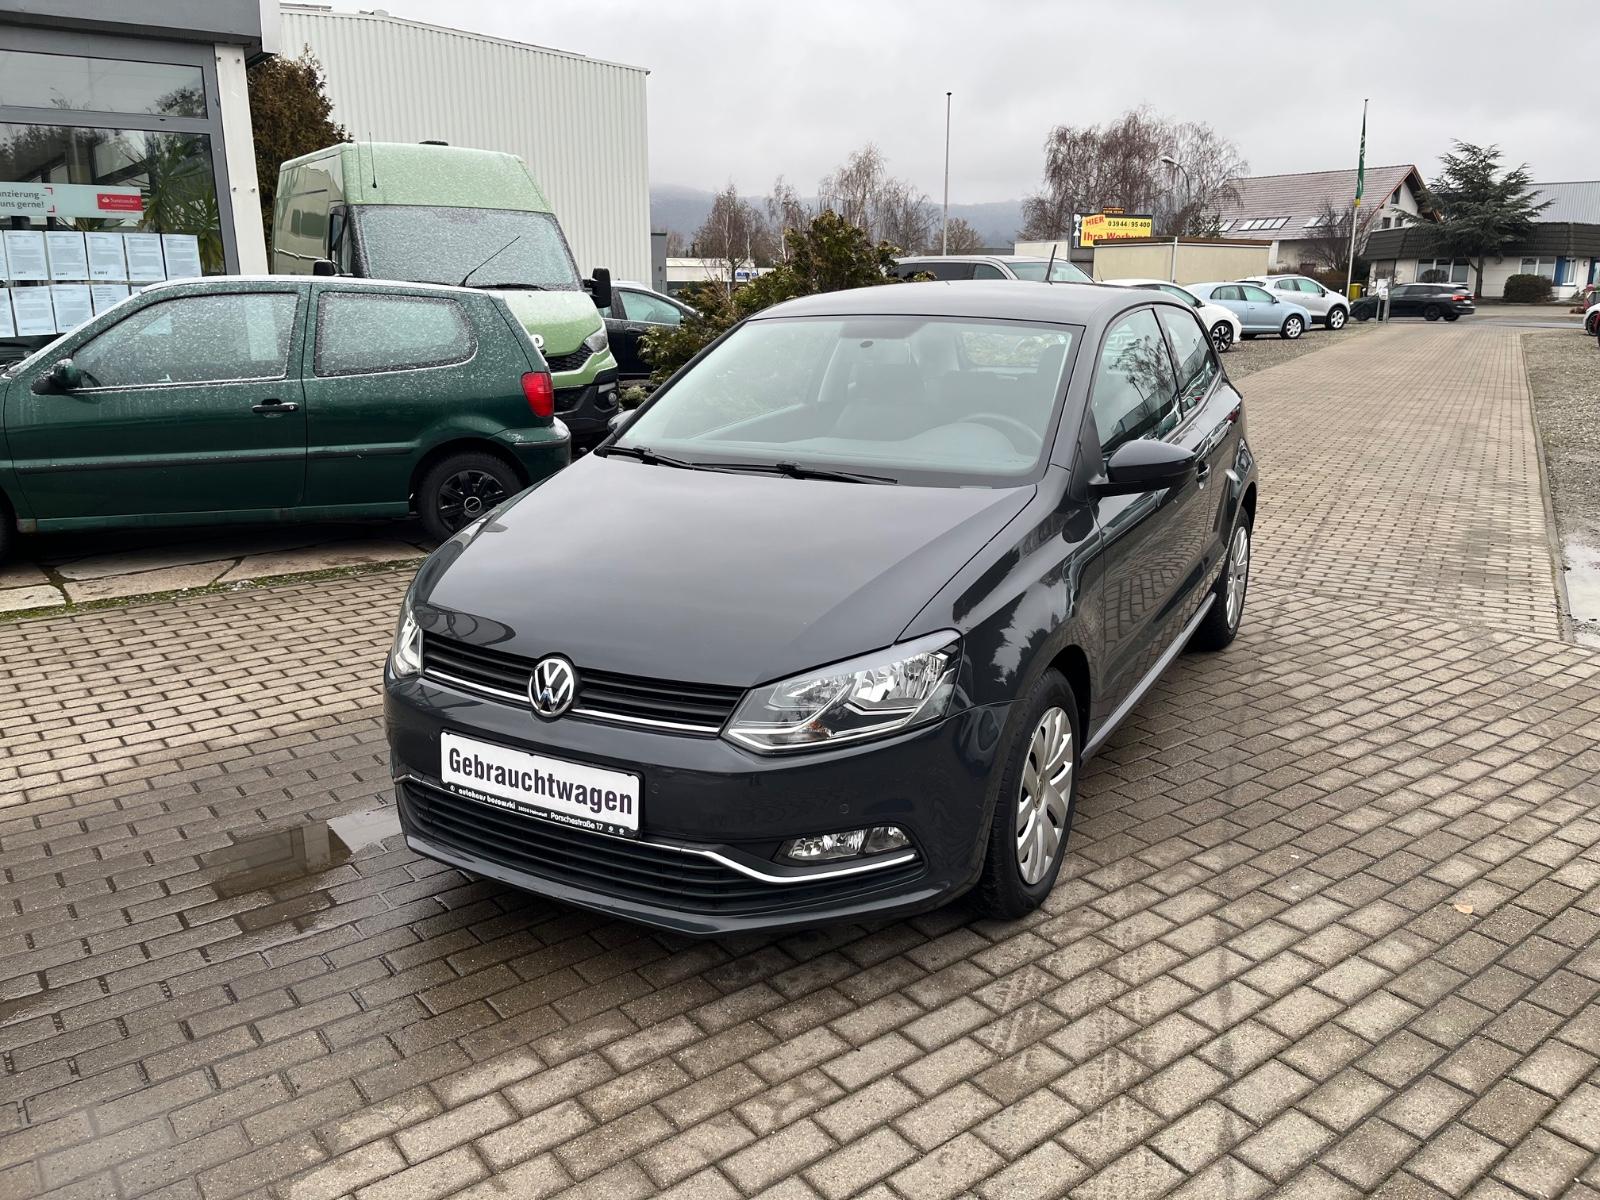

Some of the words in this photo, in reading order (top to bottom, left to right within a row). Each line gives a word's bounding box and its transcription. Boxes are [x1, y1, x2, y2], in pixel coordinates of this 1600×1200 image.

[0, 190, 40, 200] nzierung
[17, 201, 45, 210] gerne!
[1087, 216, 1104, 226] HIER
[1084, 232, 1104, 241] Ihre
[448, 747, 633, 815] Gebrauchtwagen
[550, 812, 595, 829] Porschestraße
[595, 822, 604, 831] 17
